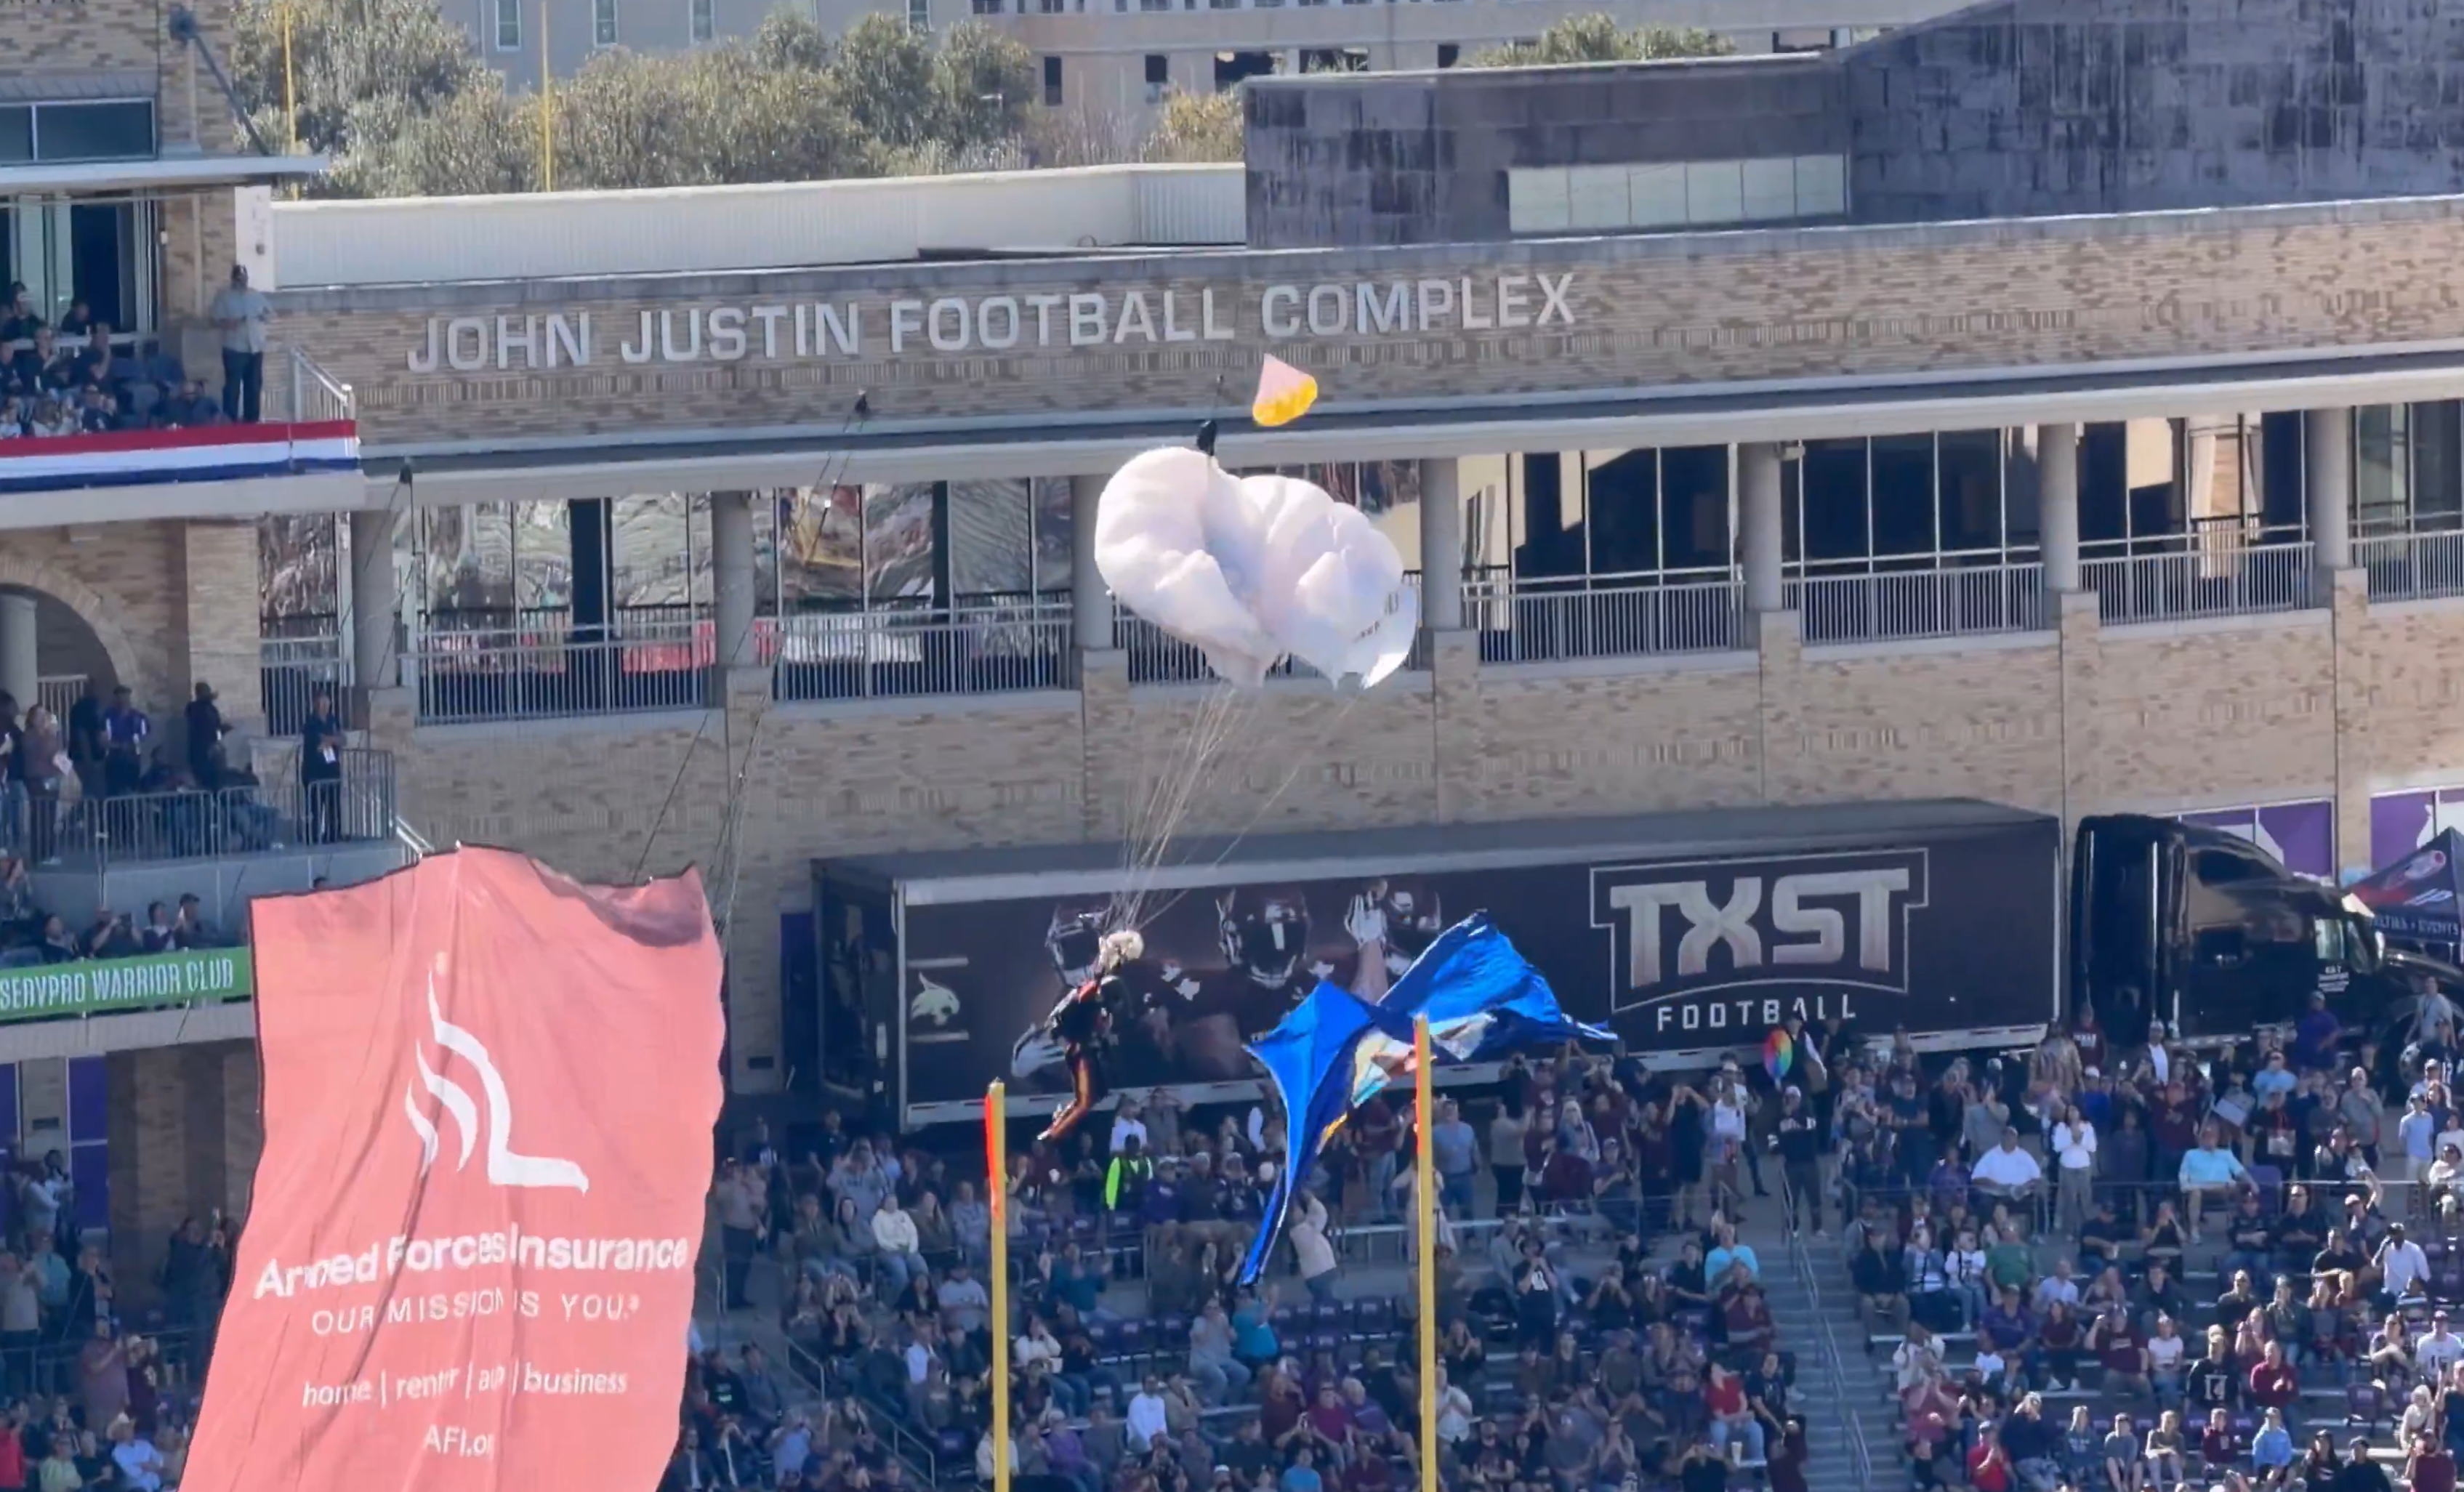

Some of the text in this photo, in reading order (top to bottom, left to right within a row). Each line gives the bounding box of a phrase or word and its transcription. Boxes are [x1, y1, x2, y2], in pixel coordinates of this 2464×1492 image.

[406, 272, 1576, 374] JOHN JUSTIN FOOTBALL COMPLEX
[1609, 868, 1910, 990] TXST
[91, 962, 182, 1001] WARRIOR
[185, 956, 234, 992] CLUB
[1656, 993, 1856, 1032] FOOTBALL
[387, 1231, 506, 1276] Forces
[510, 1221, 688, 1273] Insurance
[312, 1305, 376, 1336] OUR
[387, 1286, 504, 1324] MISSION
[513, 1289, 540, 1318] IS
[523, 1361, 628, 1395] business
